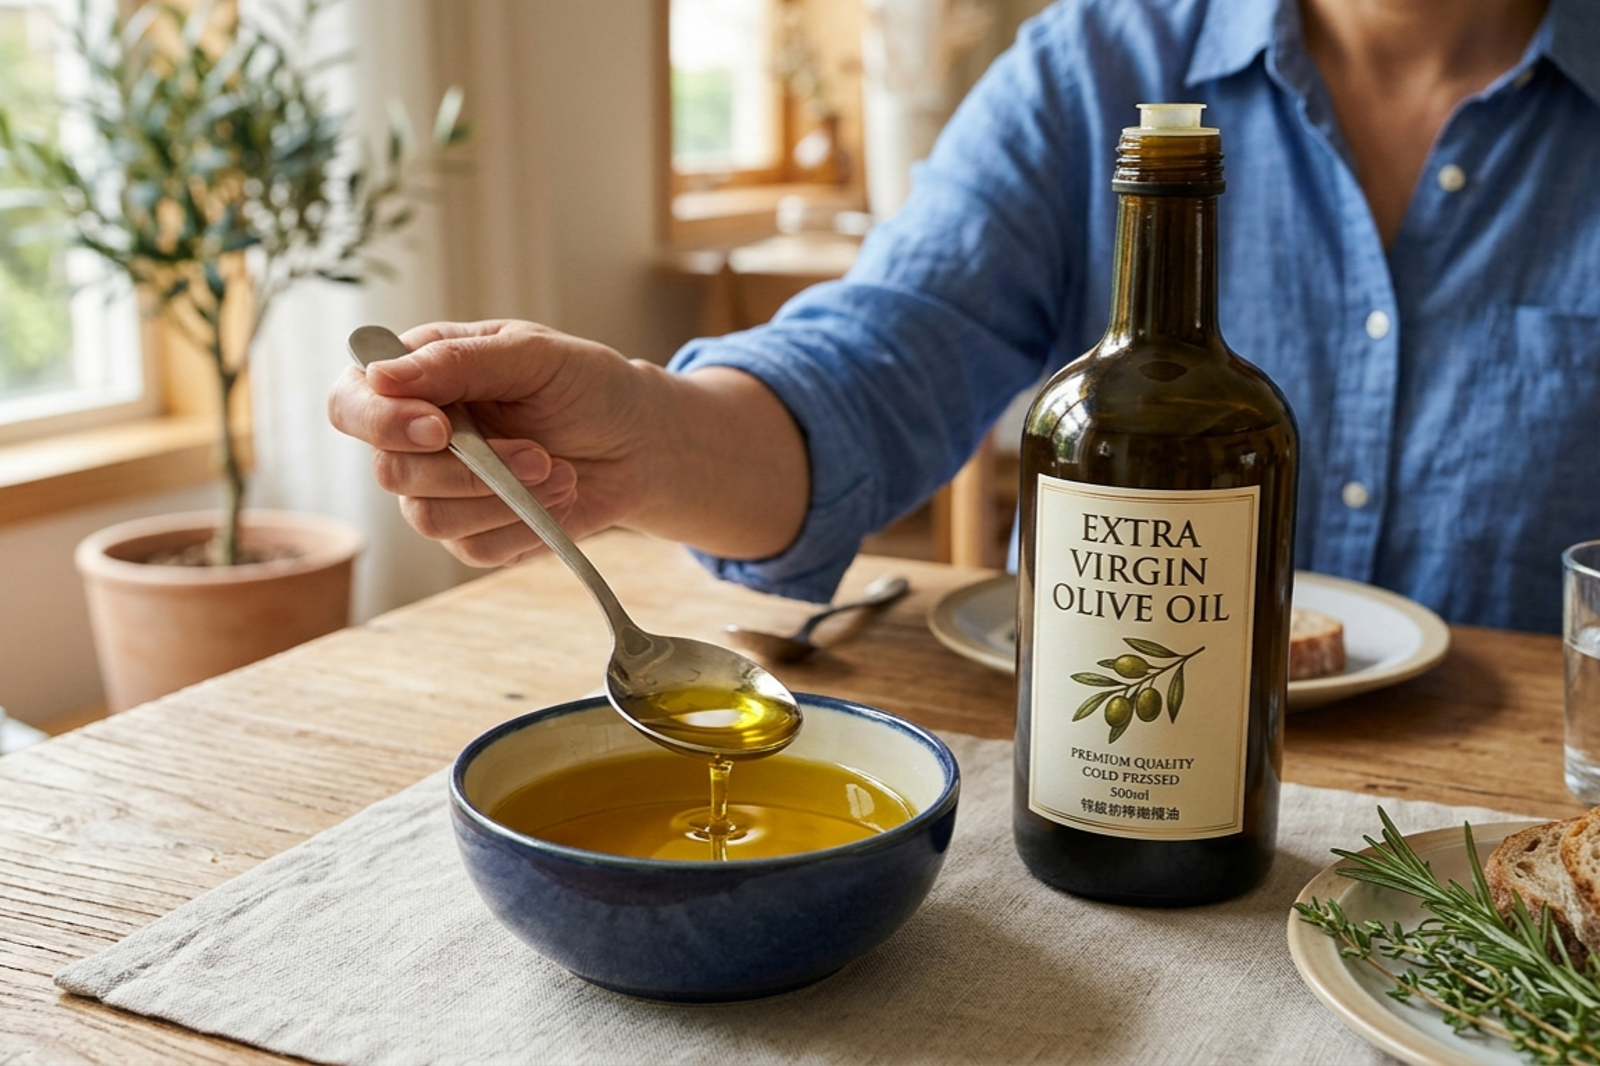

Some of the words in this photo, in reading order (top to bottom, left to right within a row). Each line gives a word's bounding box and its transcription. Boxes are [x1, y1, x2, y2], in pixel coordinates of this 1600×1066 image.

[1082, 513, 1201, 548] EXTRA
[1070, 548, 1208, 587] VIRGIN
[1053, 583, 1153, 622] OLIVE
[1166, 593, 1230, 623] OIL
[1082, 766, 1119, 781] COLD
